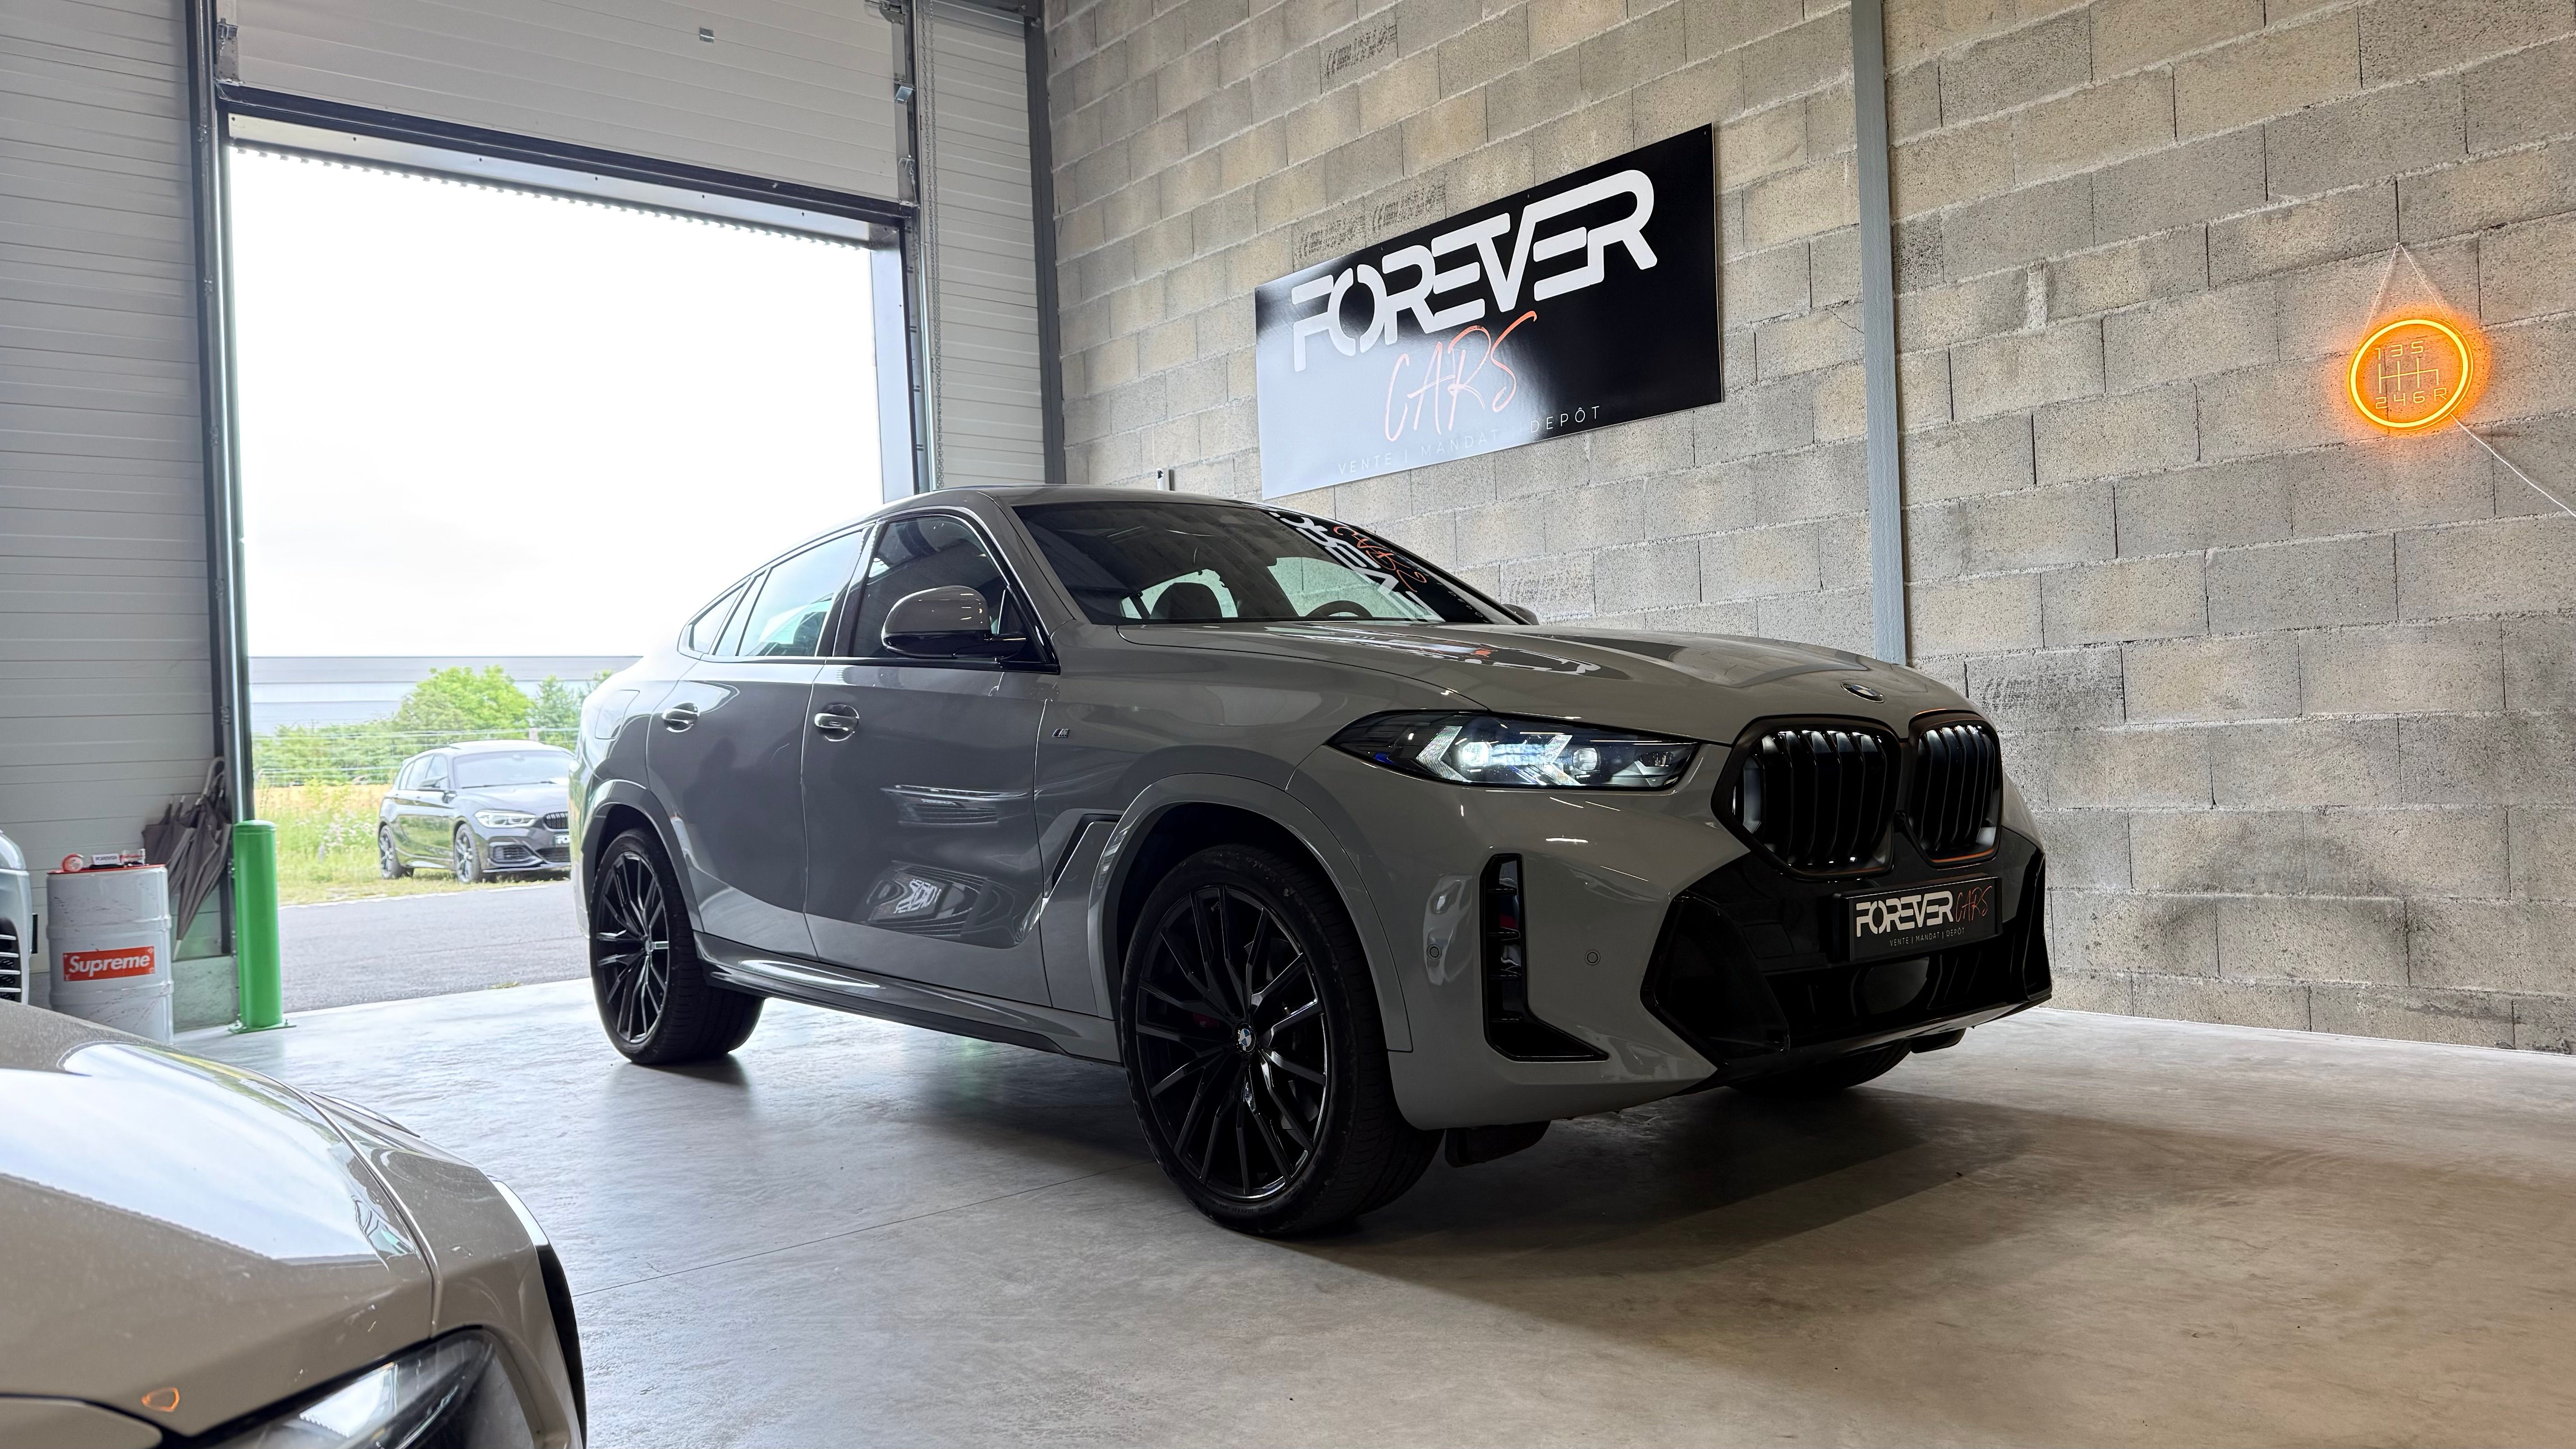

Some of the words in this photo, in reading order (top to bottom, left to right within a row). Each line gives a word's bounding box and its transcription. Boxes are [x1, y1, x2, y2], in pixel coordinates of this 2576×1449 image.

[1291, 169, 1658, 373] FOREVER
[2374, 347, 2381, 360] 1
[2391, 344, 2403, 357] 3
[2410, 340, 2424, 354] 5
[1385, 310, 1537, 442] CARS
[2375, 396, 2388, 409] 2
[2393, 392, 2406, 406] 4
[2413, 390, 2425, 404] 6
[2433, 387, 2447, 401] R
[1338, 452, 1393, 475] VENTE
[1421, 429, 1500, 457] MANDAT
[1530, 405, 1601, 433] DEPÔT
[1856, 890, 1954, 938] FOREVER
[1955, 885, 1992, 923] CARS
[1890, 937, 1909, 947] VENTE
[1916, 931, 1940, 942] MANDAT
[68, 955, 151, 977] Supreme
